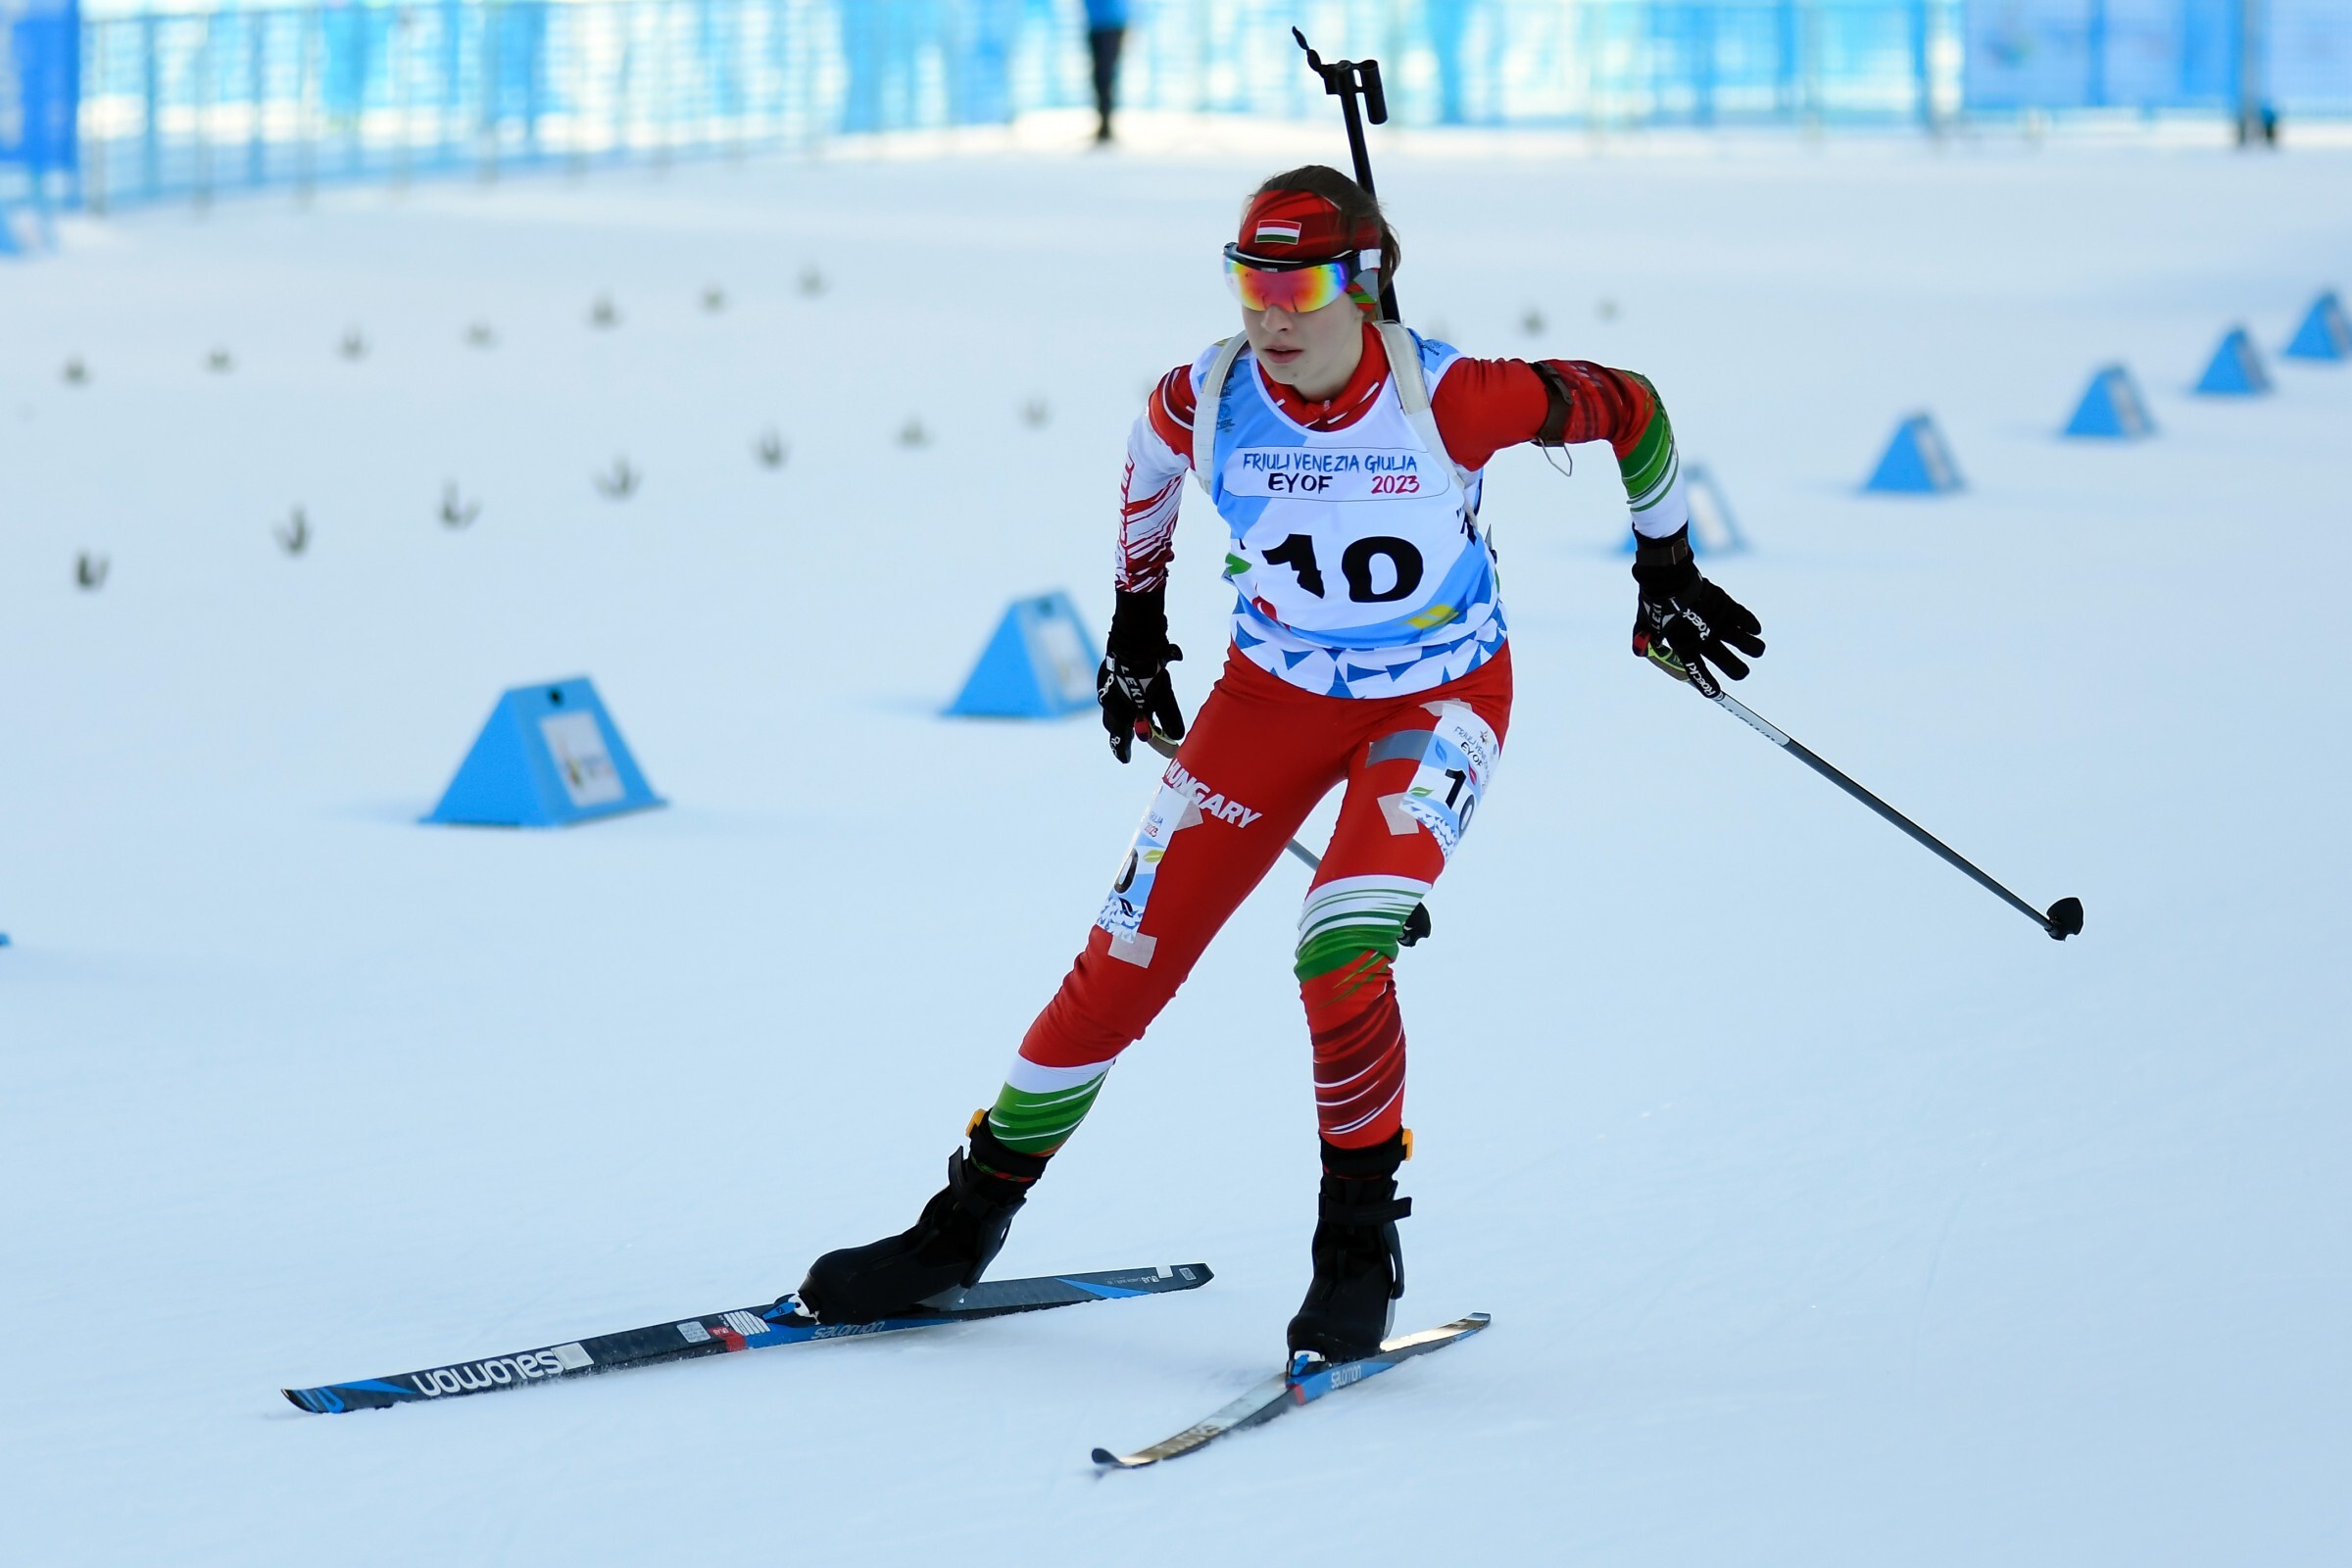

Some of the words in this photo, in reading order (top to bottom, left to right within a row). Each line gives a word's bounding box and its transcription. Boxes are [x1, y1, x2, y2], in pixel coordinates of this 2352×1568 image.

[1243, 452, 1291, 471] FRIULI
[1294, 452, 1360, 473] VENEZIA
[1364, 455, 1418, 473] GIULIA
[1267, 472, 1334, 495] EYOF
[1370, 474, 1420, 494] 2023
[1260, 533, 1425, 604] 10
[1460, 741, 1484, 767] EYOF
[1164, 758, 1263, 829] HUNGARY
[1444, 767, 1476, 840] 10
[810, 1321, 886, 1341] salomon
[412, 1350, 565, 1396] salomon
[1331, 1364, 1362, 1390] salomon
